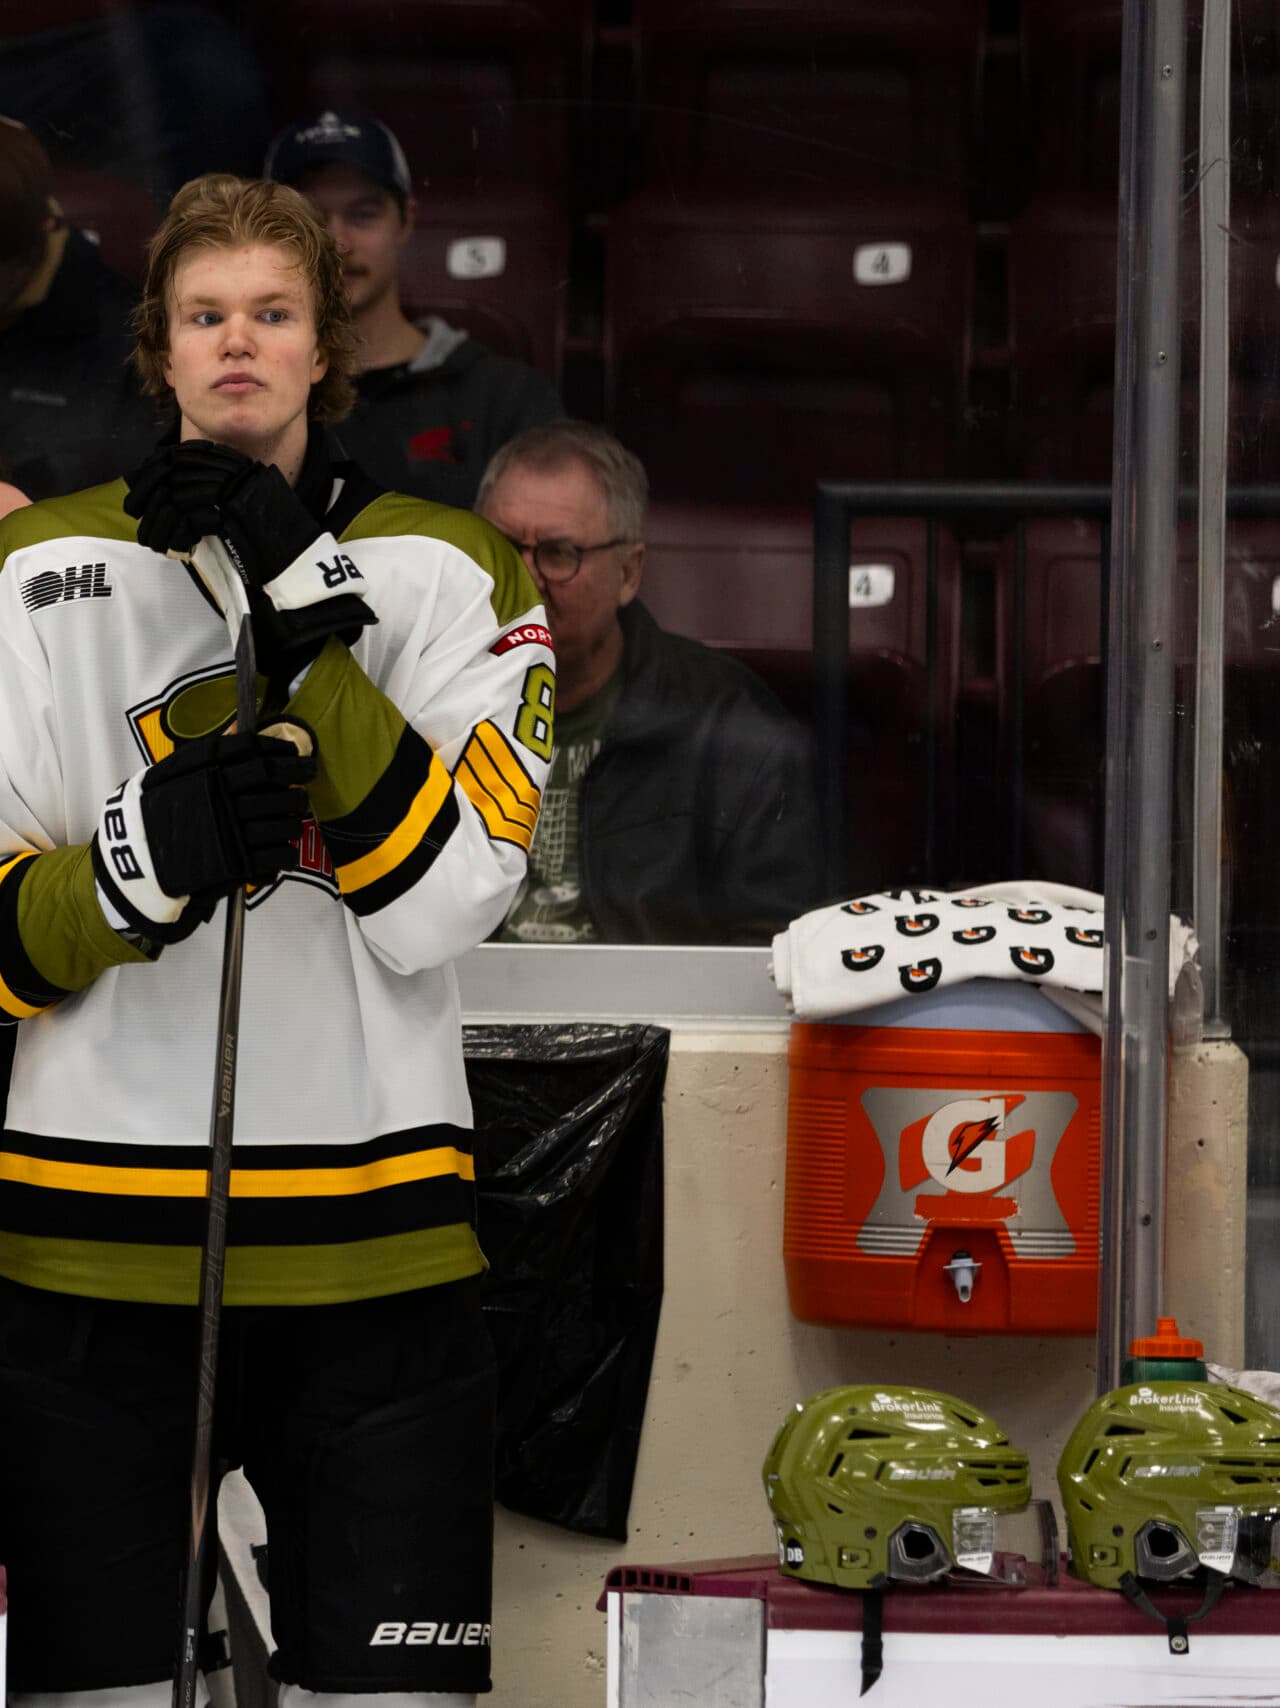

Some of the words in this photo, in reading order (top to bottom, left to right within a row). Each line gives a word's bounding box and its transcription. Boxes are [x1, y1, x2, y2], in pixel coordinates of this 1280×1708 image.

[20, 562, 113, 614] OHL
[513, 662, 558, 764] 8
[895, 914, 940, 937] G
[952, 926, 997, 945] G
[1064, 927, 1104, 948] G
[841, 944, 885, 971] G
[1009, 946, 1055, 974] G
[898, 957, 942, 993] G
[922, 1098, 1007, 1194] G
[871, 1400, 943, 1414] BrokerLink
[1130, 1393, 1202, 1406] BrokerLink
[904, 1411, 945, 1421] Insurance
[889, 1468, 957, 1481] BAUER
[786, 1547, 804, 1562] DB
[369, 1621, 492, 1647] BAUER
